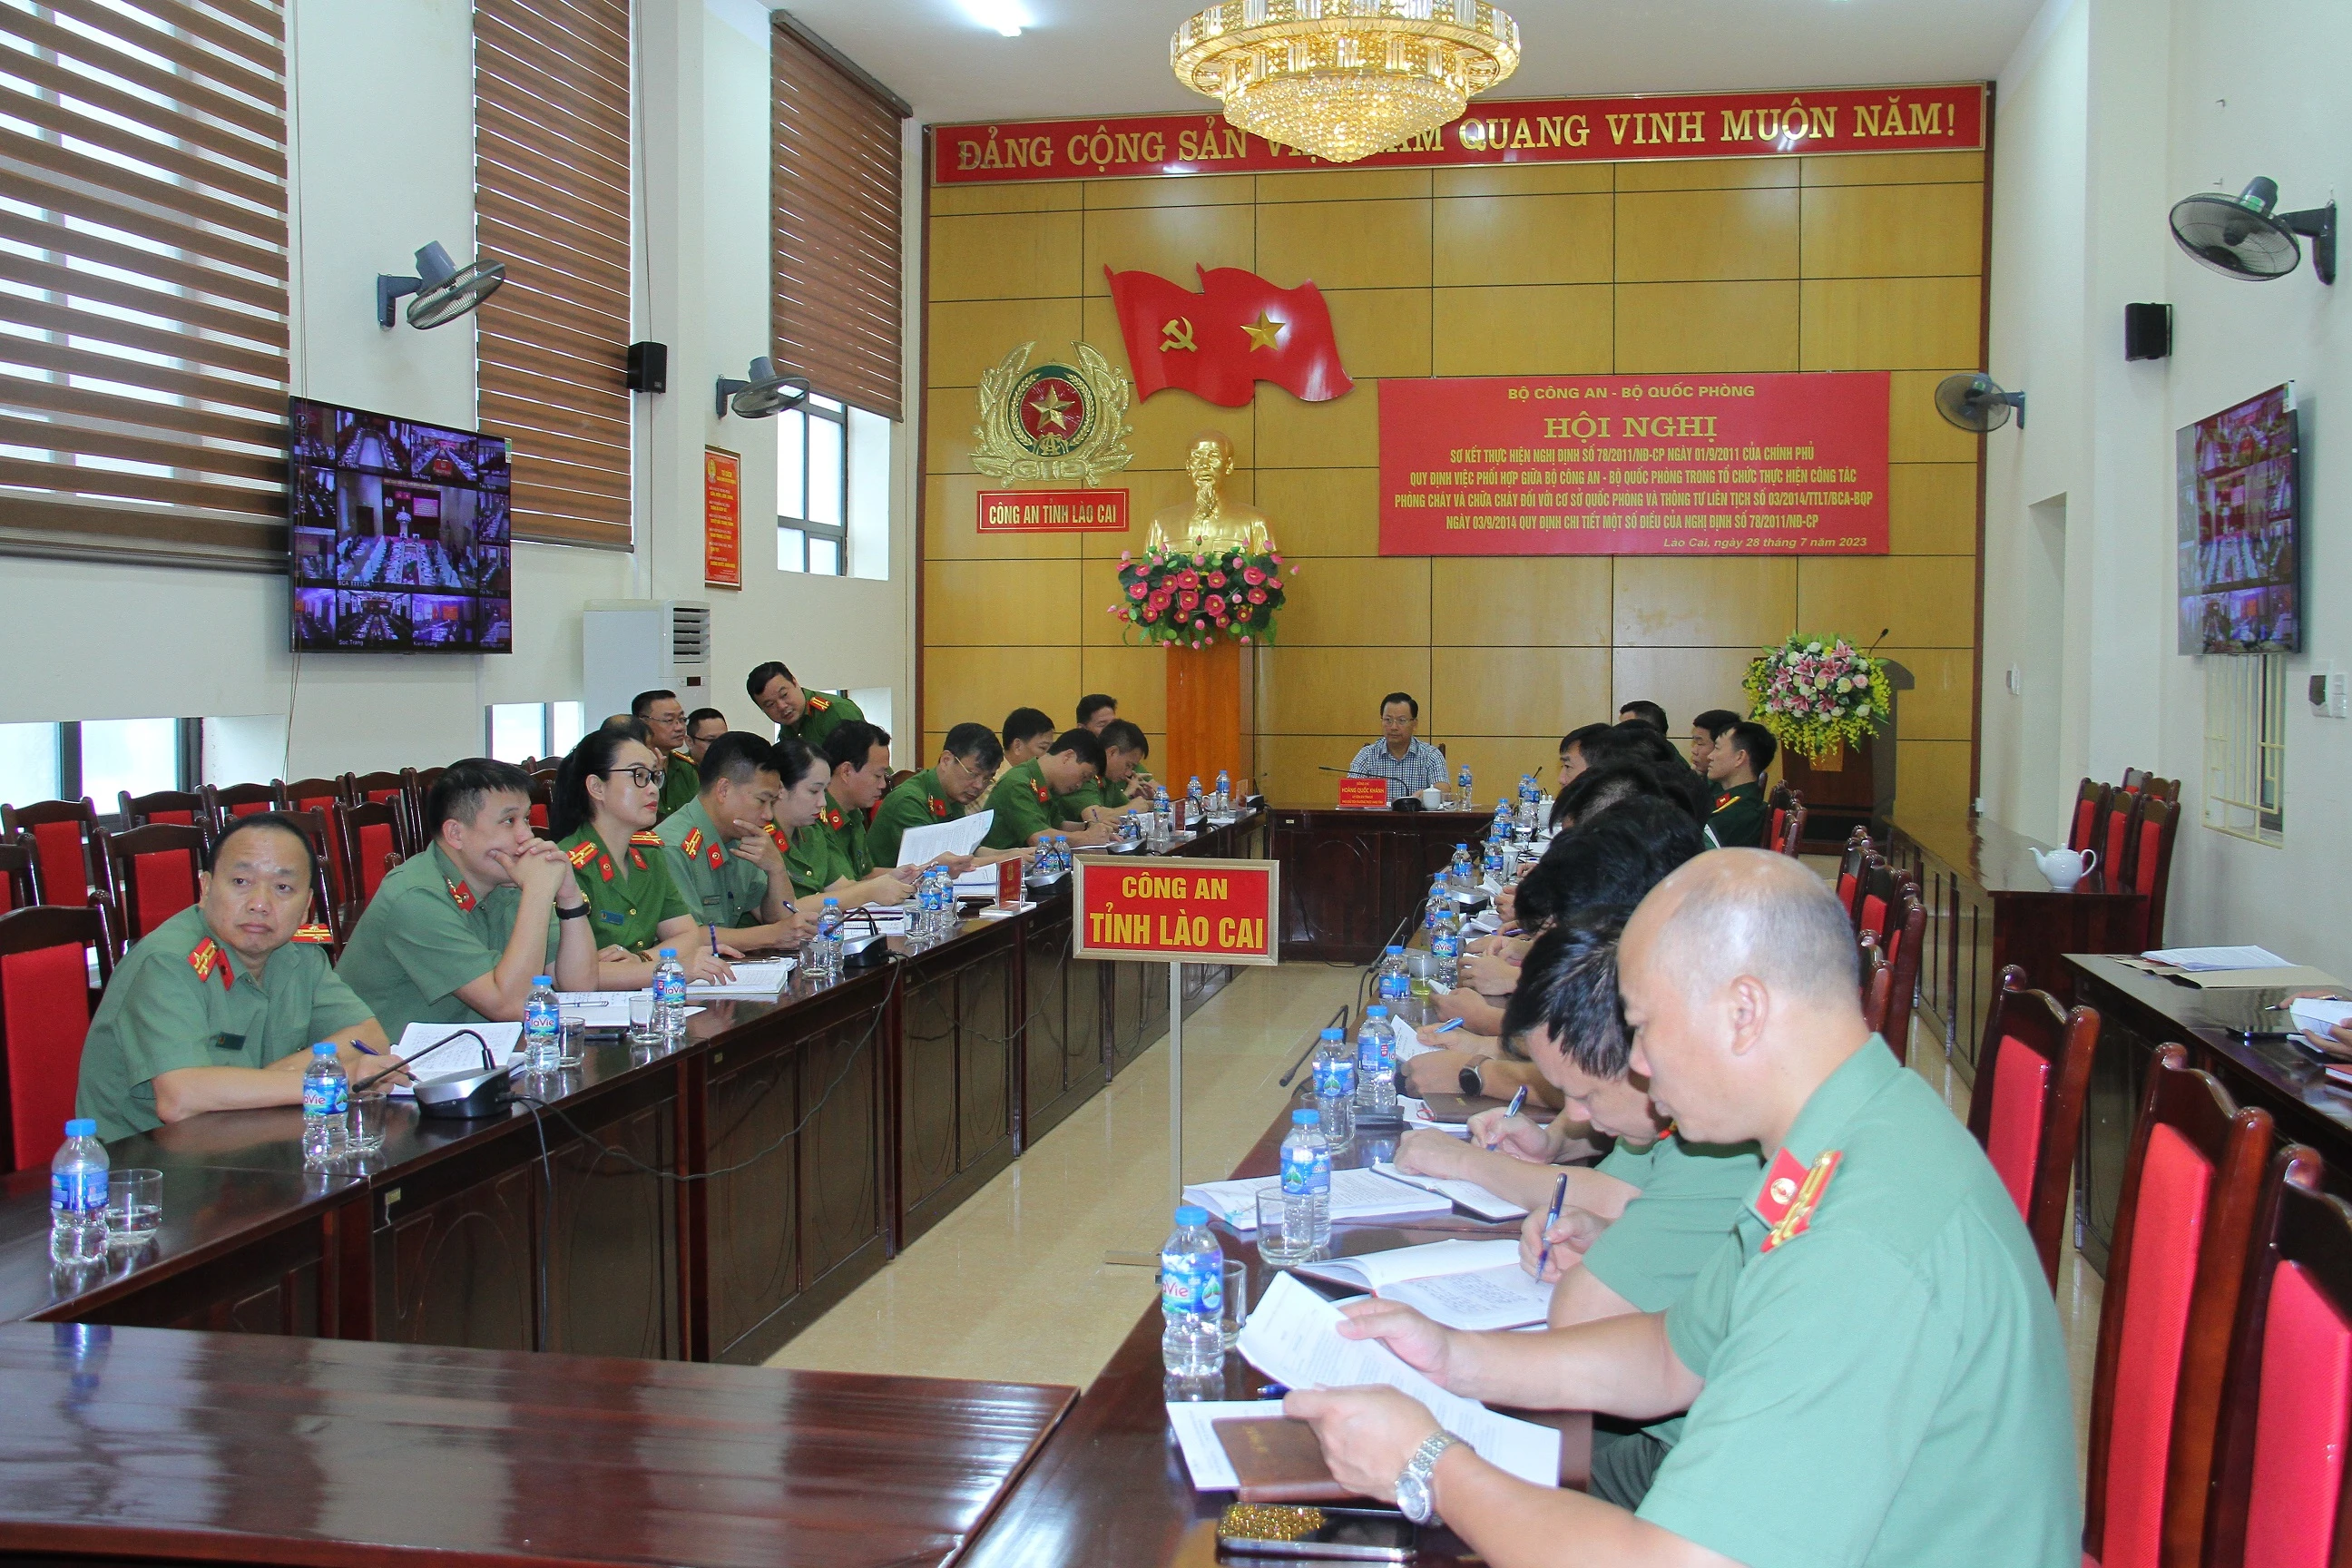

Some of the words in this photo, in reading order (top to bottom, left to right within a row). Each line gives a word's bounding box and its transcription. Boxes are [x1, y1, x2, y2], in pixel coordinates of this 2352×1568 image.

[957, 126, 1054, 171] ĐẢNG
[1067, 125, 1165, 172] CỘNG
[1179, 116, 1248, 162] SẢN
[1459, 115, 1590, 152] QUANG
[1605, 111, 1705, 144] VINH
[1720, 97, 1838, 142] MUÔN
[1853, 95, 1955, 137] NĂM!
[1508, 386, 1529, 402] BỘ
[1534, 386, 1580, 399] CÔNG
[1584, 387, 1607, 398] AN
[1622, 385, 1642, 401] BỘ
[1648, 382, 1693, 398] QUỐC
[1699, 383, 1755, 397] PHÒNG
[1544, 410, 1611, 444] HỘI
[1622, 416, 1717, 443] NGHỊ
[1450, 448, 1463, 464] SƠ
[1465, 445, 1481, 463] KẾT
[1484, 447, 1506, 466] THỰC
[1509, 446, 1530, 466] HIỆN
[1533, 447, 1555, 466] NGHỊ
[1557, 447, 1580, 465] ĐỊNH
[1582, 444, 1595, 462] SỐ
[1597, 446, 1664, 462] 78/2011/NĐ-CP
[1668, 446, 1692, 462] NGÀY
[1694, 446, 1740, 461] 01/9/2011
[1742, 441, 1761, 461] CỦA
[1764, 444, 1793, 461] CHÍNH
[1795, 441, 1815, 460] PHỦ
[1410, 471, 1427, 486] QUY
[1430, 471, 1451, 488] ĐỊNH
[1454, 469, 1475, 488] VIỆC
[1476, 466, 1497, 485] PHỐI
[1500, 470, 1518, 488] HỢP
[1521, 467, 1542, 485] GIỮA
[1544, 468, 1557, 487] BỘ
[1559, 468, 1585, 485] CÔNG
[1587, 470, 1600, 485] AN
[1609, 467, 1622, 486] BỘ
[1623, 465, 1649, 485] QUỐC
[1651, 466, 1682, 484] PHÒNG
[1685, 468, 1716, 484] TRONG
[1718, 464, 1730, 483] TỔ
[1732, 467, 1757, 484] CHỨC
[1759, 467, 1783, 486] THỰC
[1786, 466, 1808, 486] HIỆN
[1810, 466, 1836, 483] CÔNG
[1838, 464, 1857, 483] TÁC
[1395, 490, 1426, 508] PHÒNG
[1428, 491, 1451, 507] CHÁY
[1454, 490, 1465, 507] VÀ
[1467, 490, 1492, 507] CHỮA
[1494, 491, 1518, 507] CHÁY
[1520, 488, 1535, 507] ĐỐI
[1538, 490, 1553, 506] VỚI
[1555, 493, 1568, 506] CƠ
[1570, 487, 1583, 506] SỞ
[1585, 488, 1610, 507] QUỐC
[1612, 489, 1643, 506] PHÒNG
[1646, 490, 1658, 506] VÀ
[1661, 490, 1690, 506] THÔNG
[1692, 491, 1707, 506] TƯ
[1707, 490, 1727, 506] LIÊN
[1730, 492, 1750, 509] TỊCH
[1753, 487, 1767, 505] SỐ
[1769, 491, 1873, 506] 03/2014/TTLT/BCA-BQP
[989, 502, 1019, 524] CÔNG
[1024, 505, 1039, 524] AN
[1043, 498, 1069, 524] TỈNH
[1073, 501, 1093, 523] LÀO
[1097, 505, 1116, 523] CAI
[1446, 513, 1471, 530] NGÀY
[1473, 515, 1516, 529] 03/9/2014
[1519, 515, 1536, 529] QUY
[1539, 514, 1561, 532] ĐỊNH
[1563, 514, 1579, 529] CHI
[1582, 511, 1600, 529] TIẾT
[1602, 513, 1622, 532] MỘT
[1624, 510, 1637, 529] SỐ
[1640, 511, 1661, 528] ĐIỀU
[1663, 509, 1682, 528] CỦA
[1685, 514, 1707, 531] NGHỊ
[1709, 514, 1731, 531] ĐỊNH
[1734, 510, 1748, 528] SỐ
[1749, 514, 1818, 528] 78/2011/NĐ-CP
[1663, 538, 1687, 547] Lào
[1689, 538, 1710, 548] Cai,
[1714, 538, 1742, 549] ngày
[1746, 537, 1759, 546] 28
[1762, 537, 1797, 548] tháng
[1800, 537, 1808, 546] 7
[1810, 537, 1836, 546] năm
[1838, 537, 1867, 547] 2023
[1122, 872, 1186, 899] CÔNG
[1194, 878, 1228, 899] AN
[1090, 901, 1151, 944] TỈNH
[1160, 909, 1210, 947] LÀO
[1219, 917, 1262, 948] CAI
[531, 1017, 554, 1027] laVie
